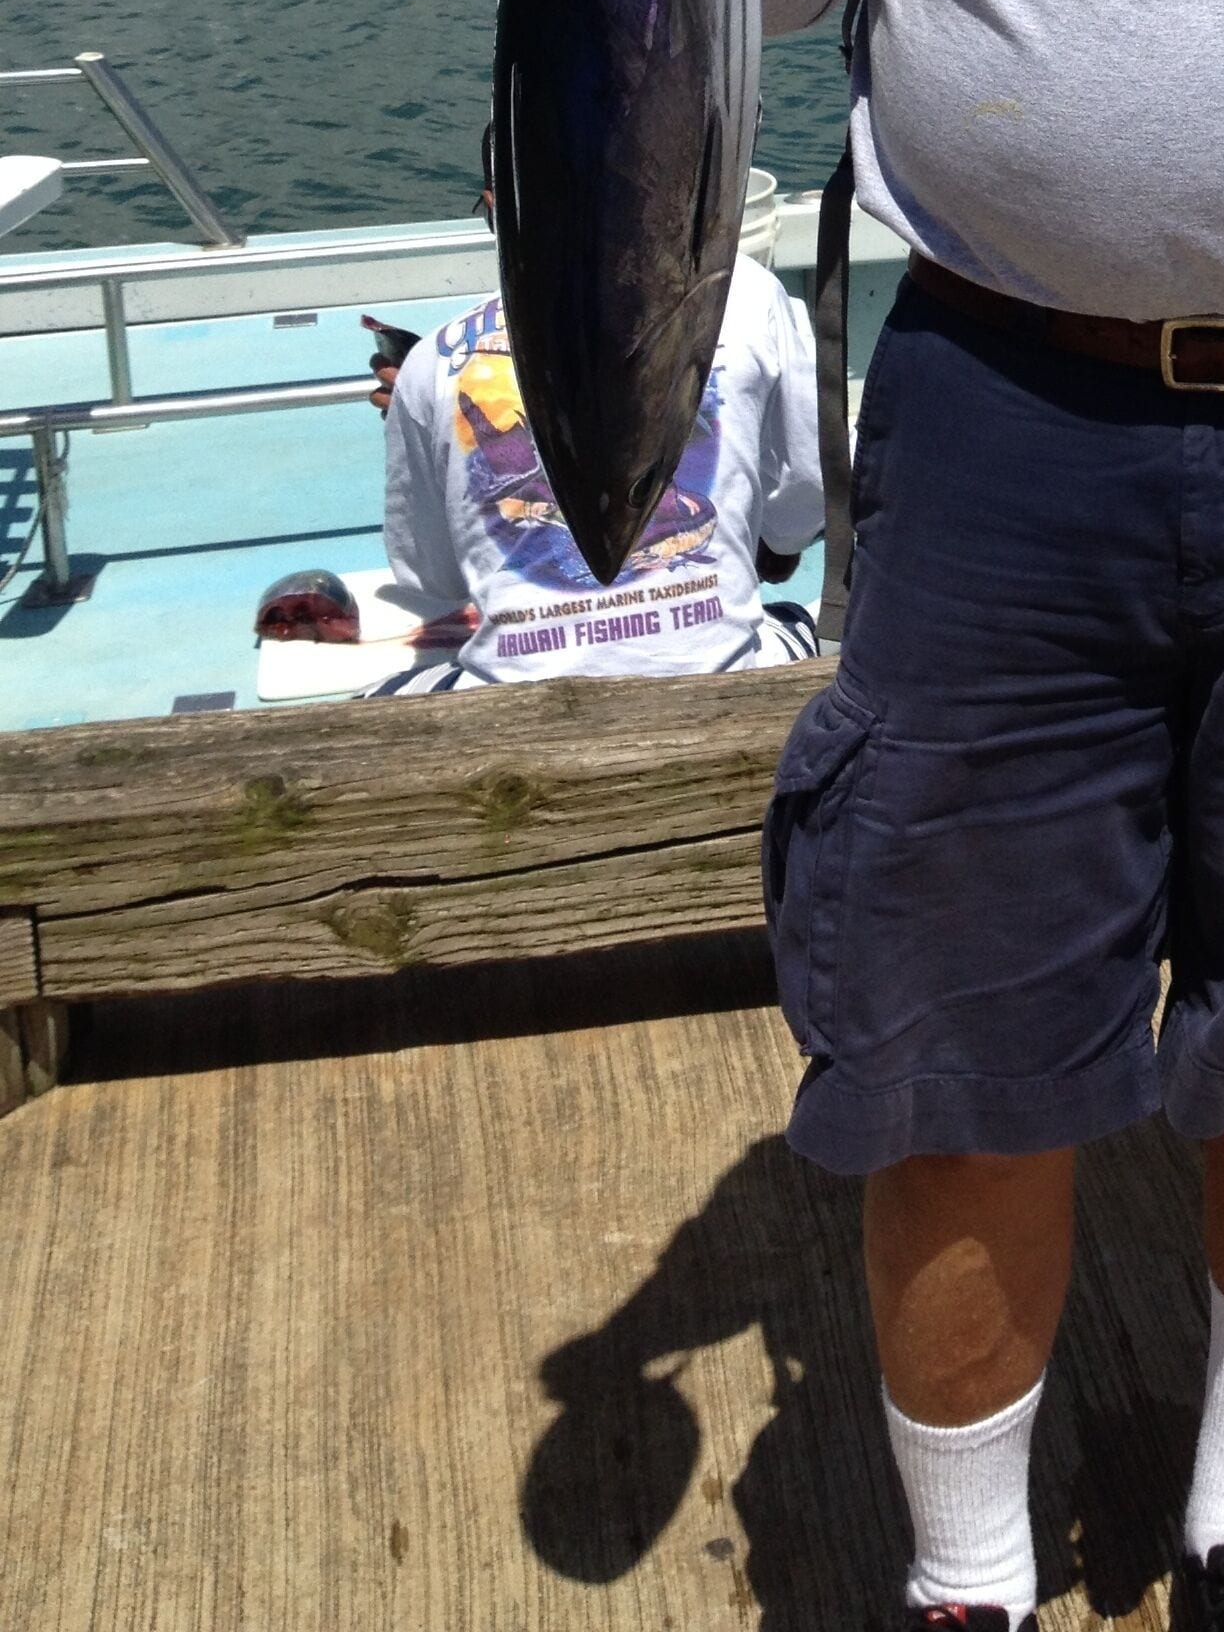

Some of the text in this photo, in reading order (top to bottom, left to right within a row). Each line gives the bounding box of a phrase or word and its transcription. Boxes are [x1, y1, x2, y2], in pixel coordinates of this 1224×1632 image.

[488, 574, 719, 626] WORLD'S LARGEST MARINE TAXIDERMIST
[496, 596, 724, 658] HAWAII FISHING TEAM
